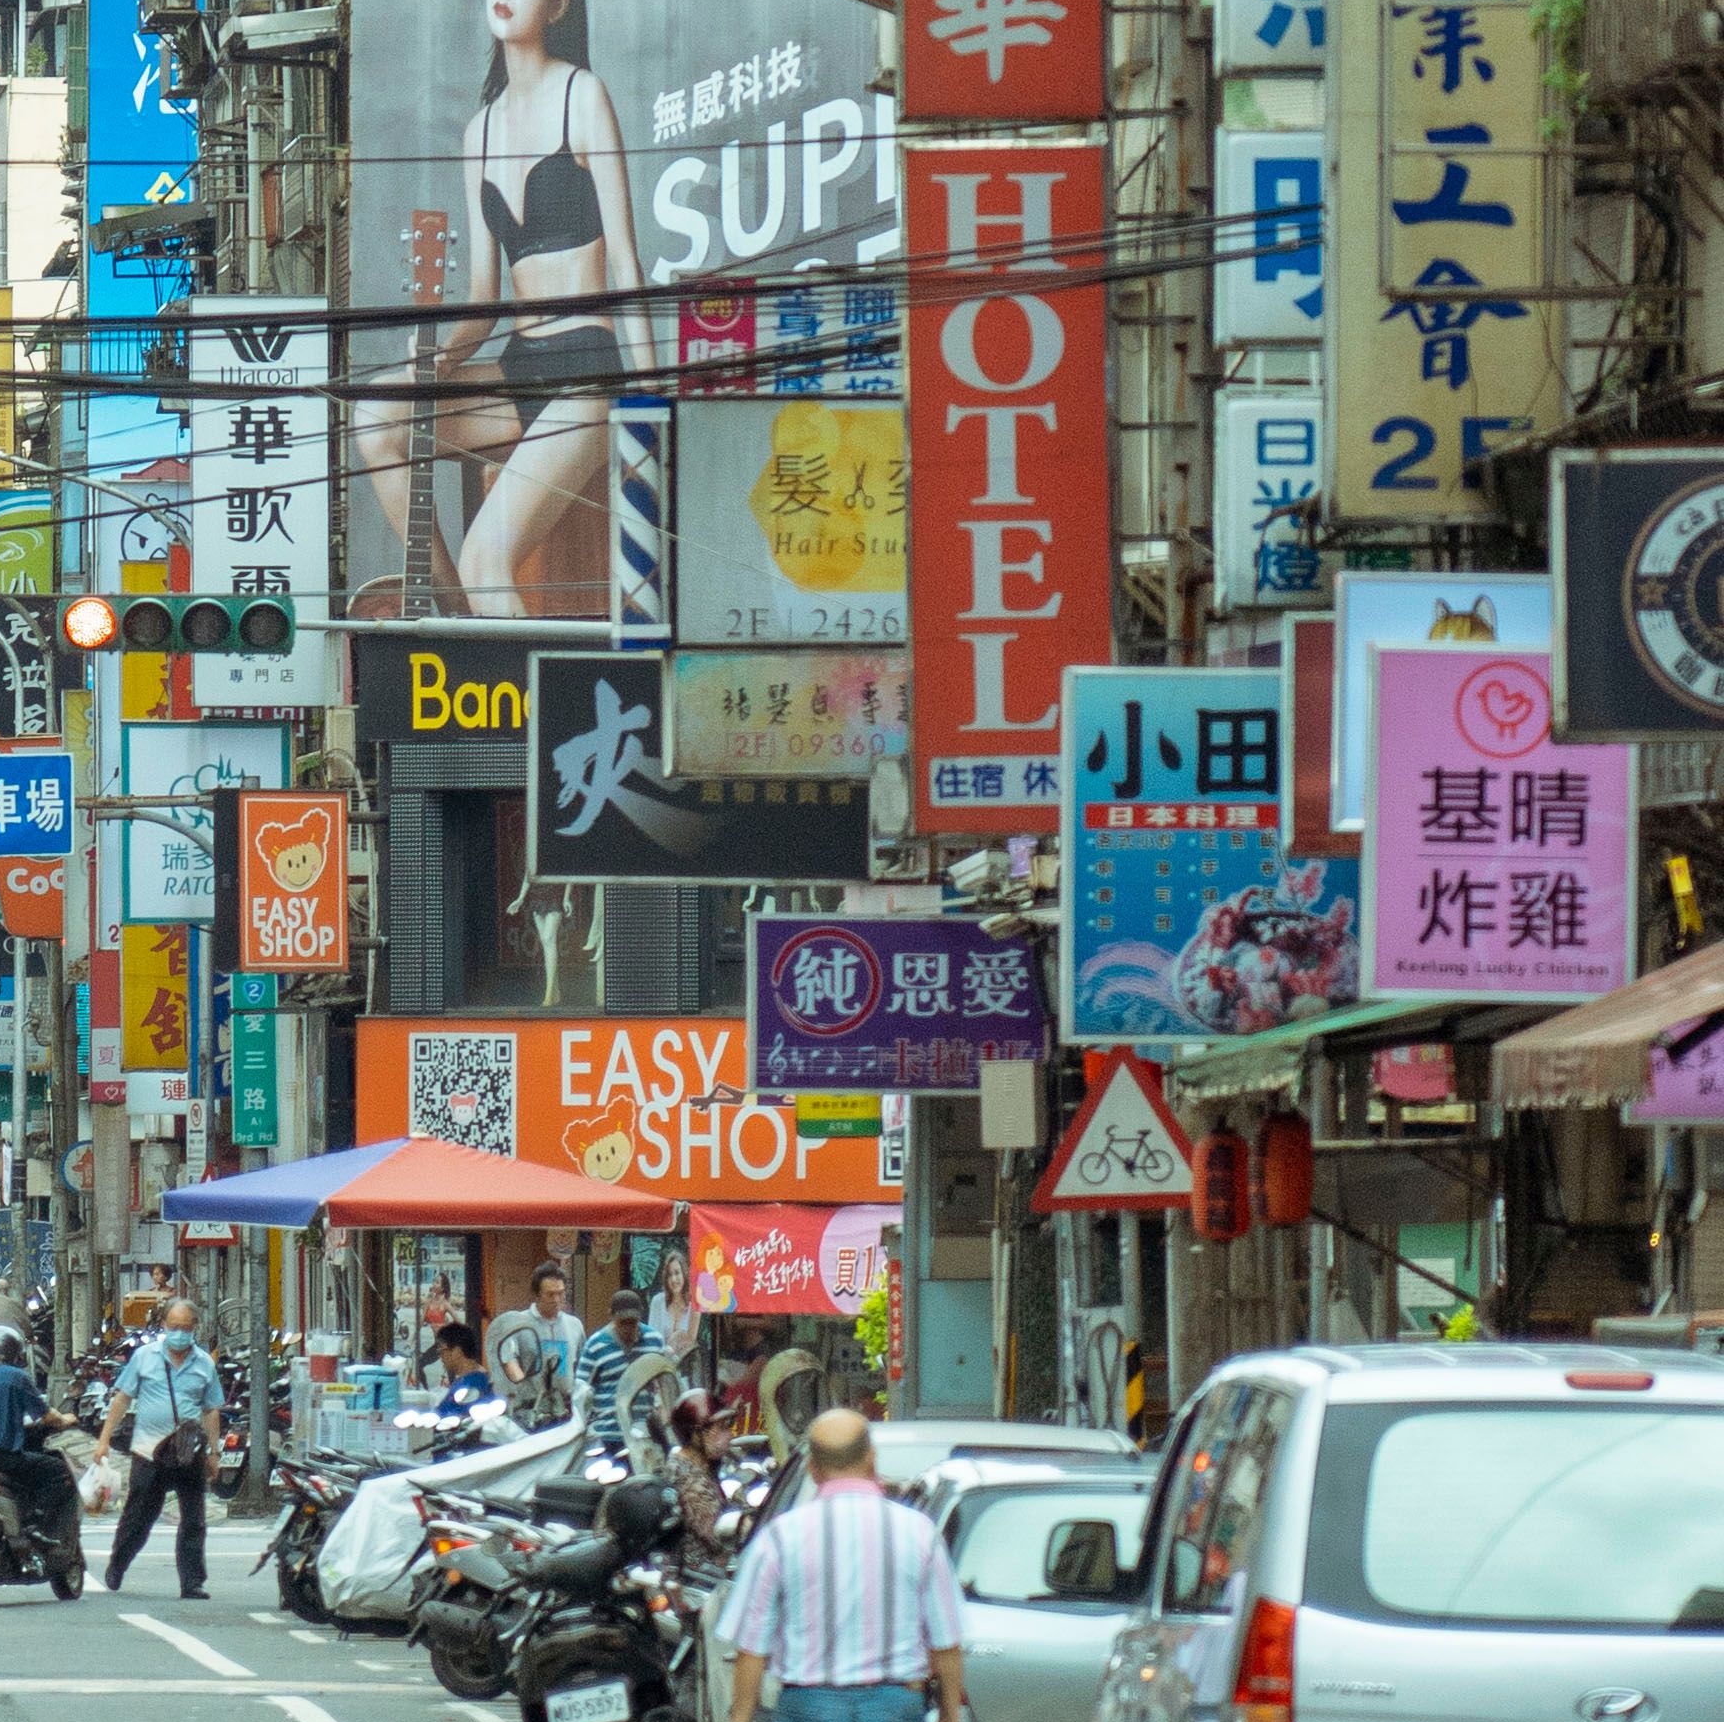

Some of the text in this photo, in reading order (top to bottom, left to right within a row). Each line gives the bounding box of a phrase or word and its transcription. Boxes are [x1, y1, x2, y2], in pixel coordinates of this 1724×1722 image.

[652, 41, 803, 143] 無感科技
[651, 92, 897, 284] SUP
[220, 366, 299, 385] Wacoal
[771, 453, 831, 516] 髮
[931, 172, 1068, 733] HOTEL
[1370, 416, 1533, 491] 2F
[1253, 419, 1322, 592] 日光燈
[775, 531, 839, 555] Hair
[726, 608, 901, 637] 2F 2426
[229, 669, 294, 683] 專門店
[410, 653, 529, 730] Ban
[734, 734, 772, 758] 2F
[1086, 700, 1279, 799] 小田
[935, 762, 1059, 799] 住宿 休
[1420, 767, 1591, 847] 基晴
[1107, 806, 1259, 827] 日本料理
[252, 897, 319, 927] EASY
[258, 927, 335, 958] SHOP
[1418, 869, 1591, 950] 炸雞
[250, 985, 258, 996] 2
[792, 947, 1031, 1018] 純恩愛
[1395, 960, 1609, 977] Keelung Lucky Chicken
[243, 1014, 267, 1111] 愛三路
[561, 1029, 730, 1106] EASY
[251, 1117, 262, 1126] Ai
[638, 1106, 829, 1180] SHOP
